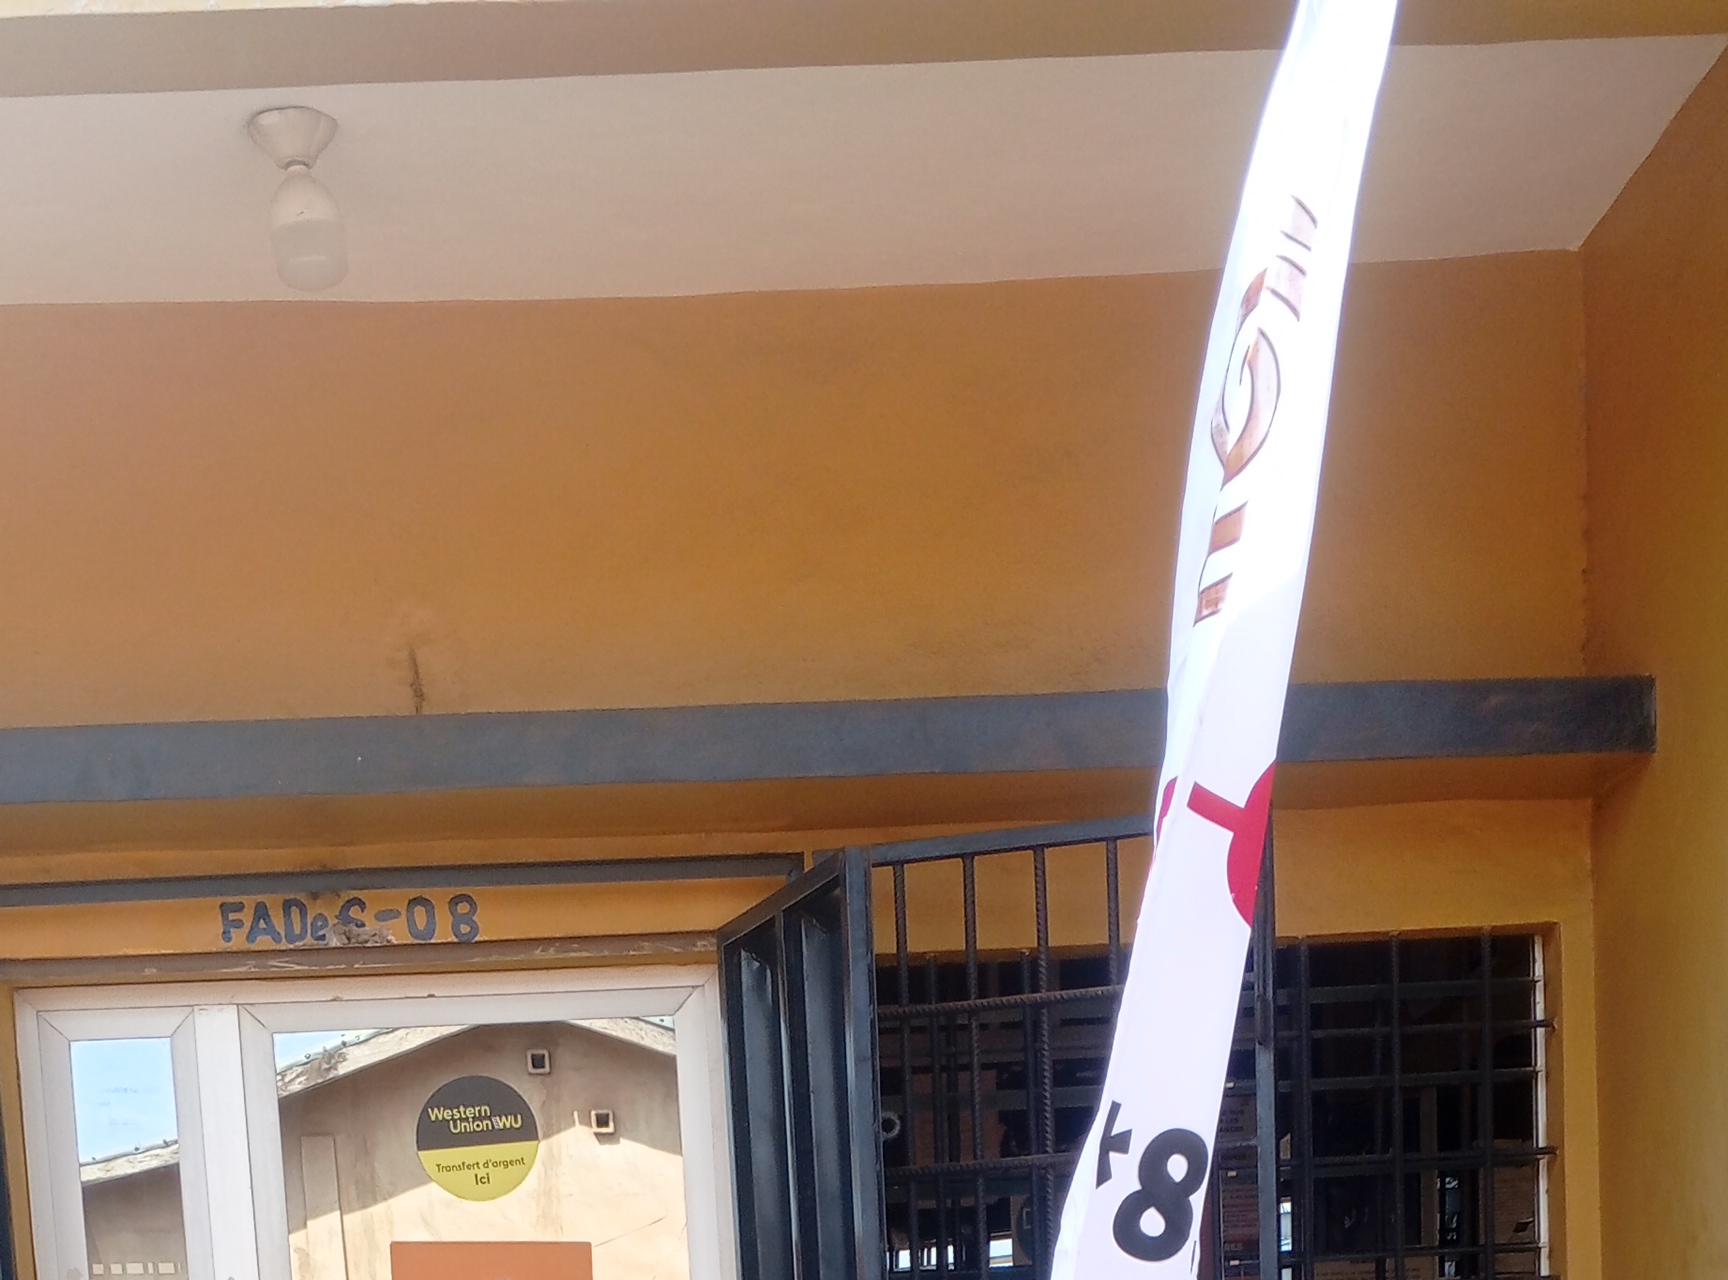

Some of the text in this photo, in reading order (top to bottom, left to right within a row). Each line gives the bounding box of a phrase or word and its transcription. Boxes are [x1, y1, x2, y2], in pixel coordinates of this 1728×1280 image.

[428, 1104, 491, 1121] Western
[449, 1119, 492, 1133] Union
[436, 1157, 526, 1173] Transfert d'argent
[475, 1172, 491, 1185] Ici
